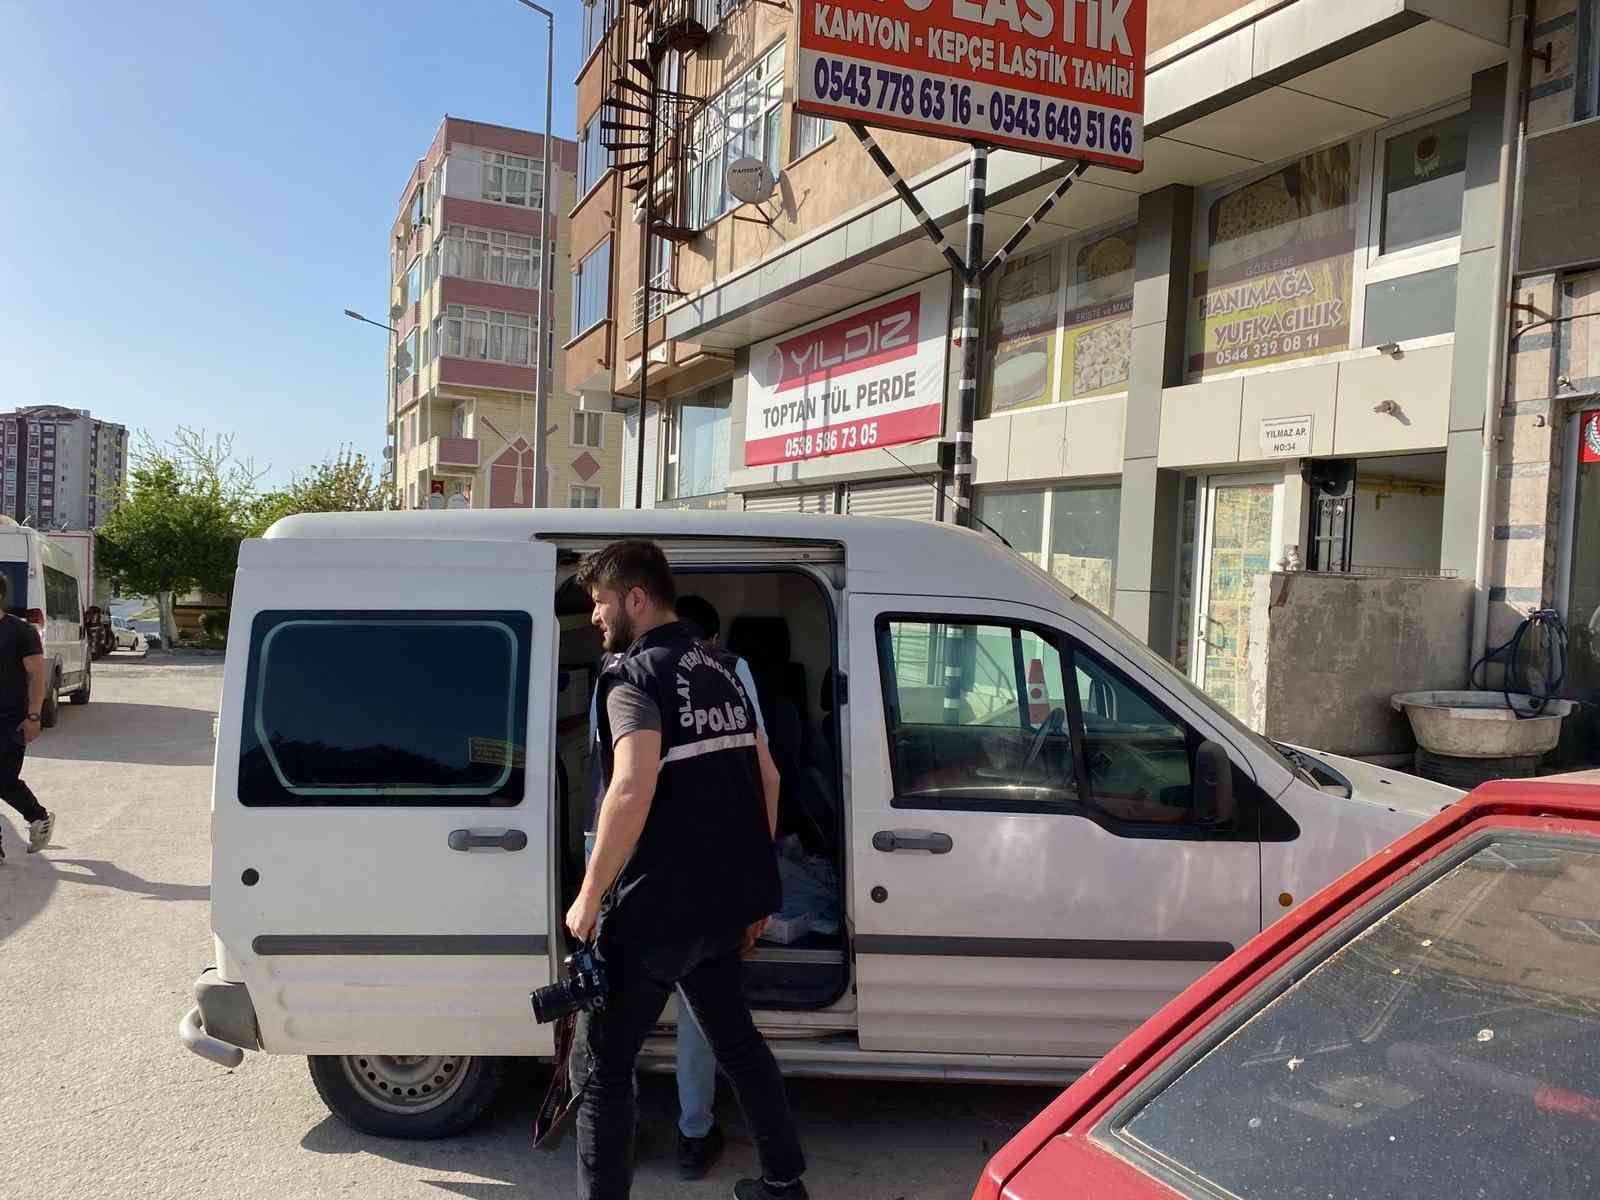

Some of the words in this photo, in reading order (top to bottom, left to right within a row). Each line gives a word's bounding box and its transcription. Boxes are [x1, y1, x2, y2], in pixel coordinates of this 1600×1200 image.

[814, 3, 911, 54] KAMYON
[927, 26, 995, 72] KEPÇE
[998, 42, 1068, 86] LASTİK
[1071, 57, 1134, 99] TAMİRİ
[813, 56, 872, 109] 0543
[875, 68, 915, 116] 778
[918, 78, 946, 121] 63
[949, 83, 972, 125] 16
[988, 91, 1041, 139] 0543
[1044, 102, 1082, 146] 649
[1085, 111, 1105, 149] 51
[1109, 115, 1133, 154] 66
[790, 310, 913, 375] YILDIZ
[1215, 347, 1249, 365] 0544
[1252, 342, 1279, 358] 332
[1282, 335, 1301, 352] 08
[1305, 333, 1320, 348] 11
[762, 396, 816, 429] TOPTAN
[820, 386, 850, 417] TÜL
[856, 370, 917, 410] PERDE
[785, 434, 812, 458] 0538
[841, 426, 857, 449] 73
[860, 422, 878, 446] 05
[1265, 428, 1293, 439] YILMAZ
[676, 673, 694, 728] OLAY
